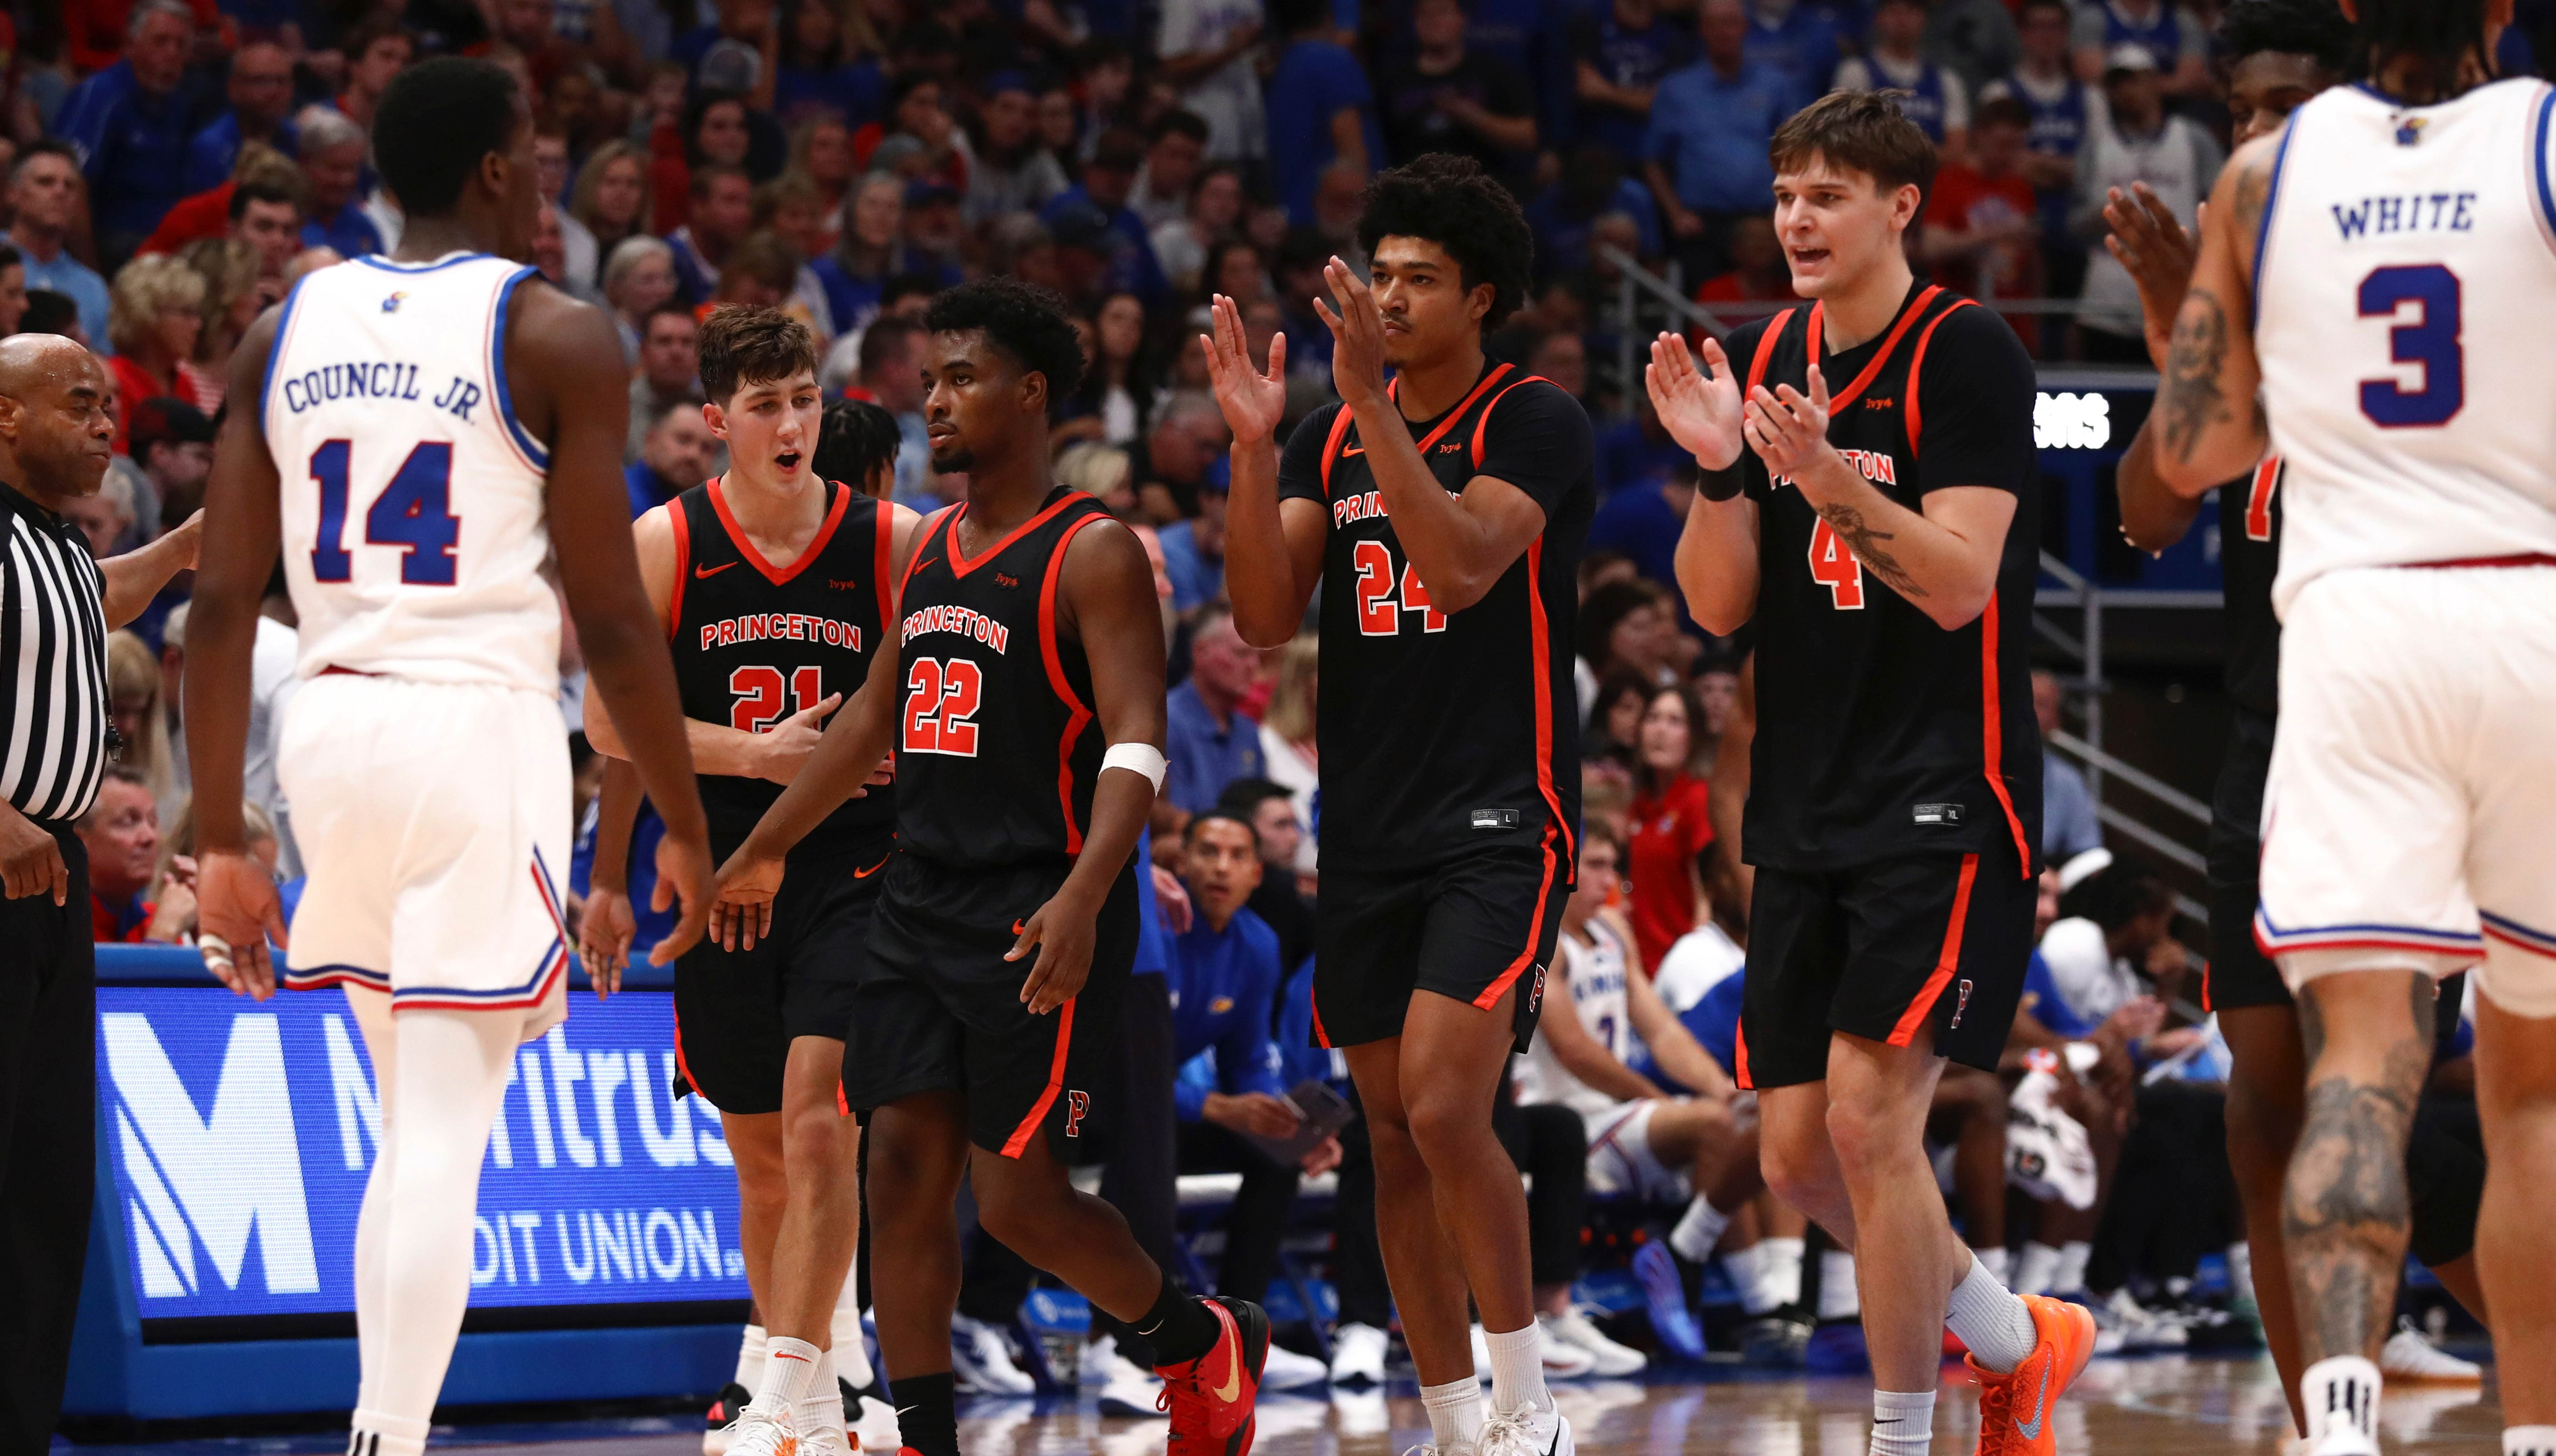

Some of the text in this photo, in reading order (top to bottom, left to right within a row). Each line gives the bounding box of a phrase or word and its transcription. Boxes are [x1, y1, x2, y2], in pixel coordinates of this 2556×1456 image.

[2331, 192, 2478, 242] WHITE
[2357, 262, 2465, 429] 3
[286, 362, 420, 414] COUNCIL
[1439, 444, 1454, 453] Ivy
[309, 438, 461, 586] 14
[829, 579, 846, 590] Ivy
[994, 573, 1012, 586] Ivy
[1353, 540, 1447, 636] 24
[1808, 515, 1865, 610] 4
[700, 613, 861, 653] PRINCETON
[902, 605, 1009, 656] PRINCETON
[729, 665, 822, 734] 21
[903, 657, 982, 758] 22
[1950, 979, 1973, 1029] P
[1066, 1090, 1090, 1137] P
[557, 1207, 723, 1284] UNION
